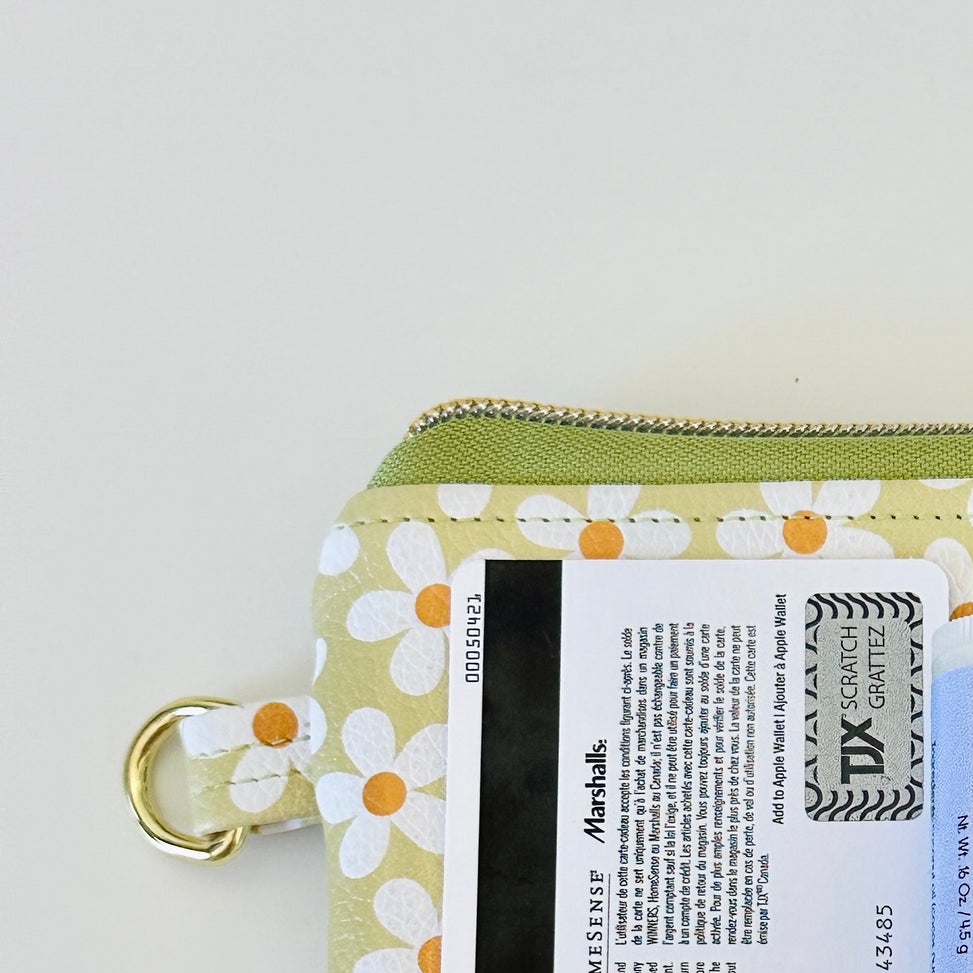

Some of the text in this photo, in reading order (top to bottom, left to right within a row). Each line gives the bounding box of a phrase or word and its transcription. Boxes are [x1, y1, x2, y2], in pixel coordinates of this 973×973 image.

[773, 593, 787, 627] Wallet
[773, 629, 789, 661] Apple
[772, 662, 786, 670] à
[838, 625, 859, 709] SCRATCH
[866, 624, 887, 708] GRATTEZ
[772, 671, 788, 712] Ajouter
[772, 718, 785, 754] Wallet
[839, 716, 886, 784] TJX
[771, 755, 787, 787] Apple
[583, 740, 607, 843] Marshalls
[772, 788, 785, 800] to
[771, 802, 784, 824] Add
[957, 837, 969, 860] Wt.
[875, 904, 893, 970] 43485
[958, 920, 971, 941] 4.5
[956, 944, 968, 955] g
